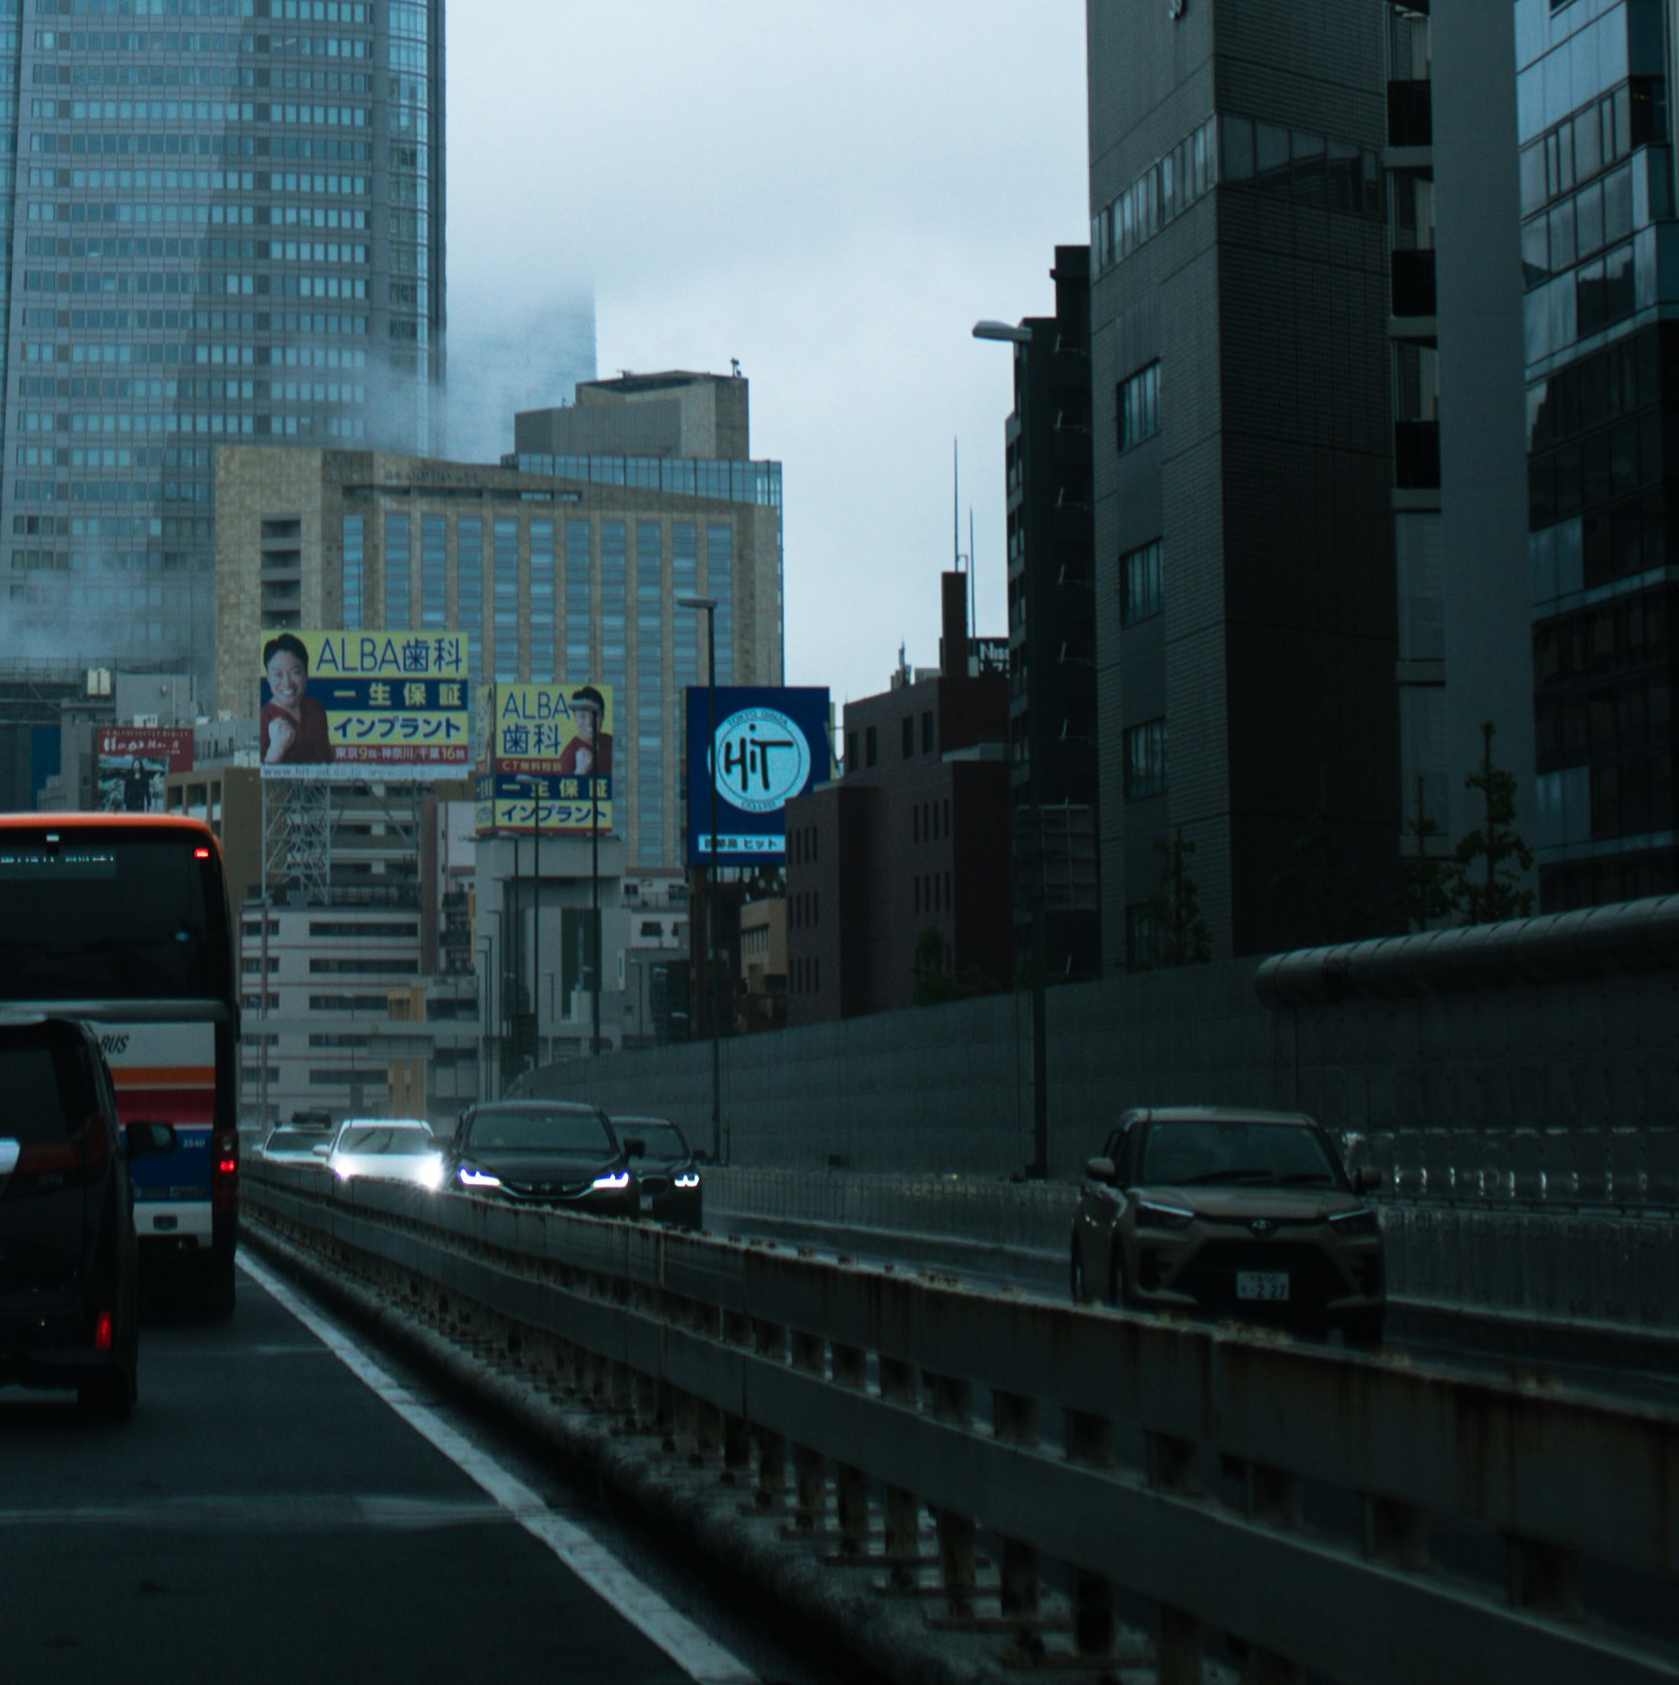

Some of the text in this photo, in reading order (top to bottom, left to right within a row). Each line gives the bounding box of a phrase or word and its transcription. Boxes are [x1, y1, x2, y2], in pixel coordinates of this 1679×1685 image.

[316, 637, 462, 673] ALBA歯科
[333, 682, 462, 707] 一生保証
[502, 691, 570, 720] ALBA
[334, 716, 461, 738] インプラント
[502, 723, 561, 755] 歯科
[100, 1034, 129, 1057] BUS
